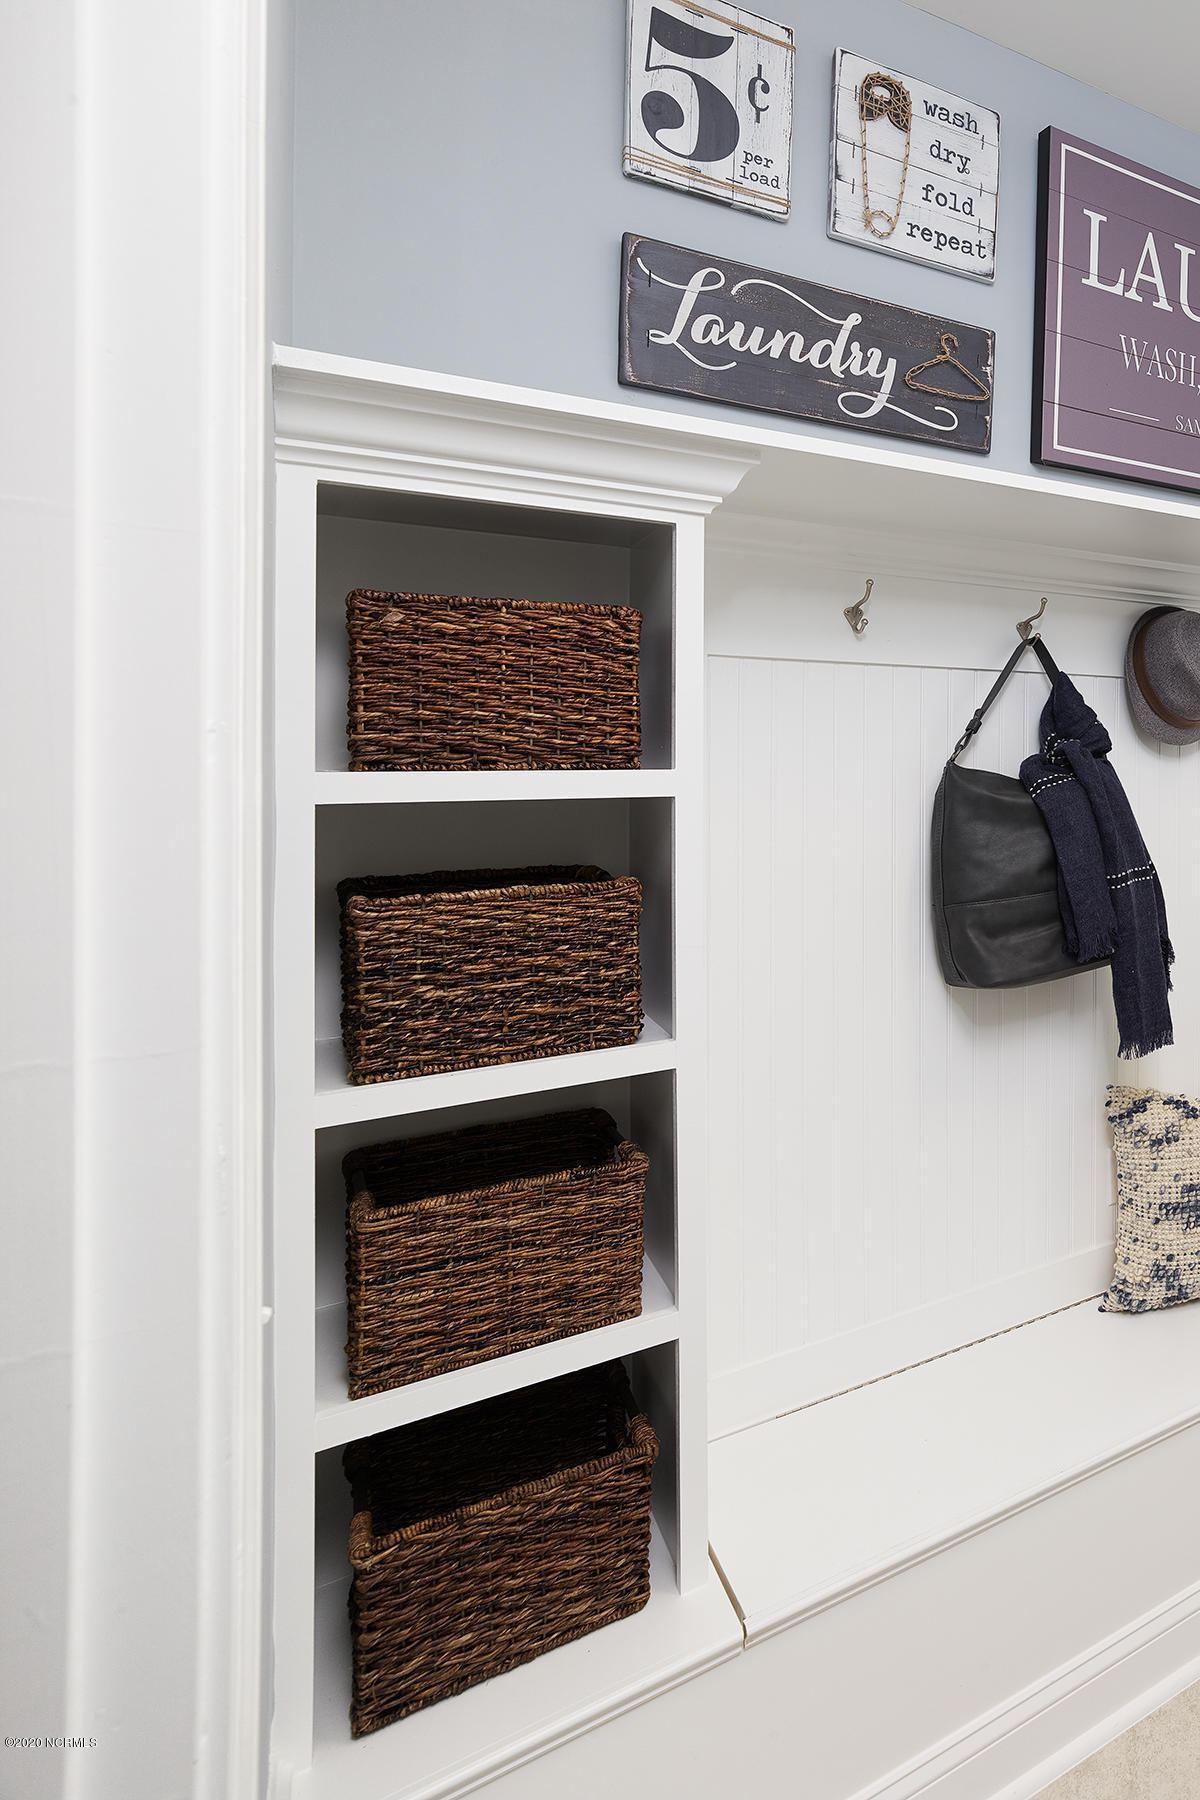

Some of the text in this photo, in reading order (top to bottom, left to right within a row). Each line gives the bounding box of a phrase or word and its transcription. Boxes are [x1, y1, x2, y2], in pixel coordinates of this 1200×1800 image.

[922, 99, 980, 135] wash
[742, 149, 774, 171] per
[929, 139, 972, 174] dry
[739, 165, 781, 190] load
[921, 183, 975, 218] fold
[905, 222, 988, 260] repeat
[636, 257, 958, 431] Laundry
